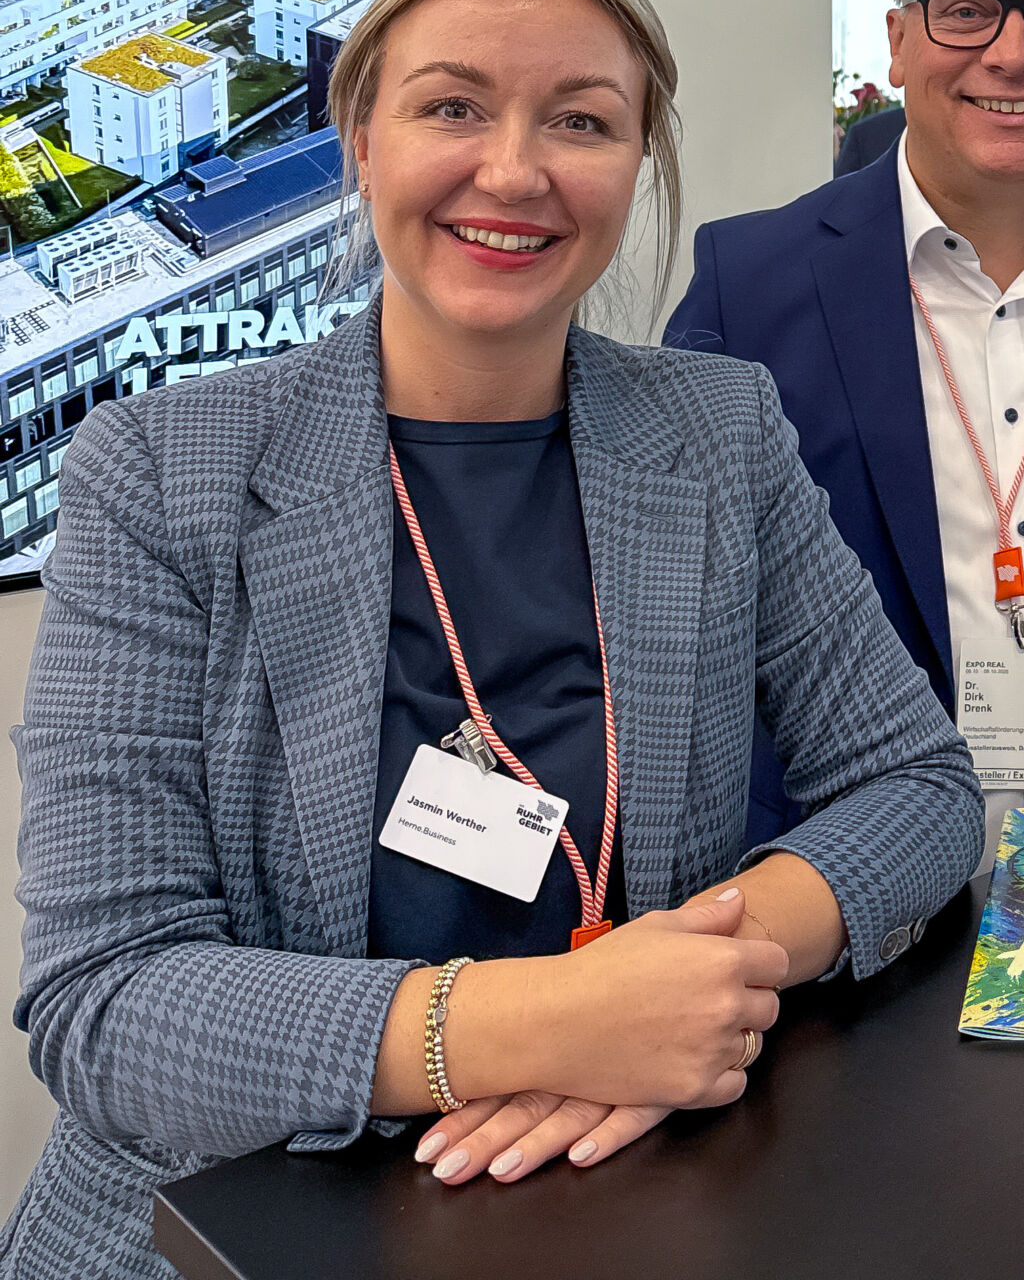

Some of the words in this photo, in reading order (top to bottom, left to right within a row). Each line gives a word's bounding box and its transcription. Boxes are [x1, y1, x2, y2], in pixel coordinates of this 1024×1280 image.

[964, 692, 984, 701] Dirk
[964, 704, 993, 713] Drenk
[407, 795, 443, 816] Jasmin
[446, 809, 487, 833] Werther
[516, 807, 543, 824] RUHR
[518, 817, 553, 836] GEBIET
